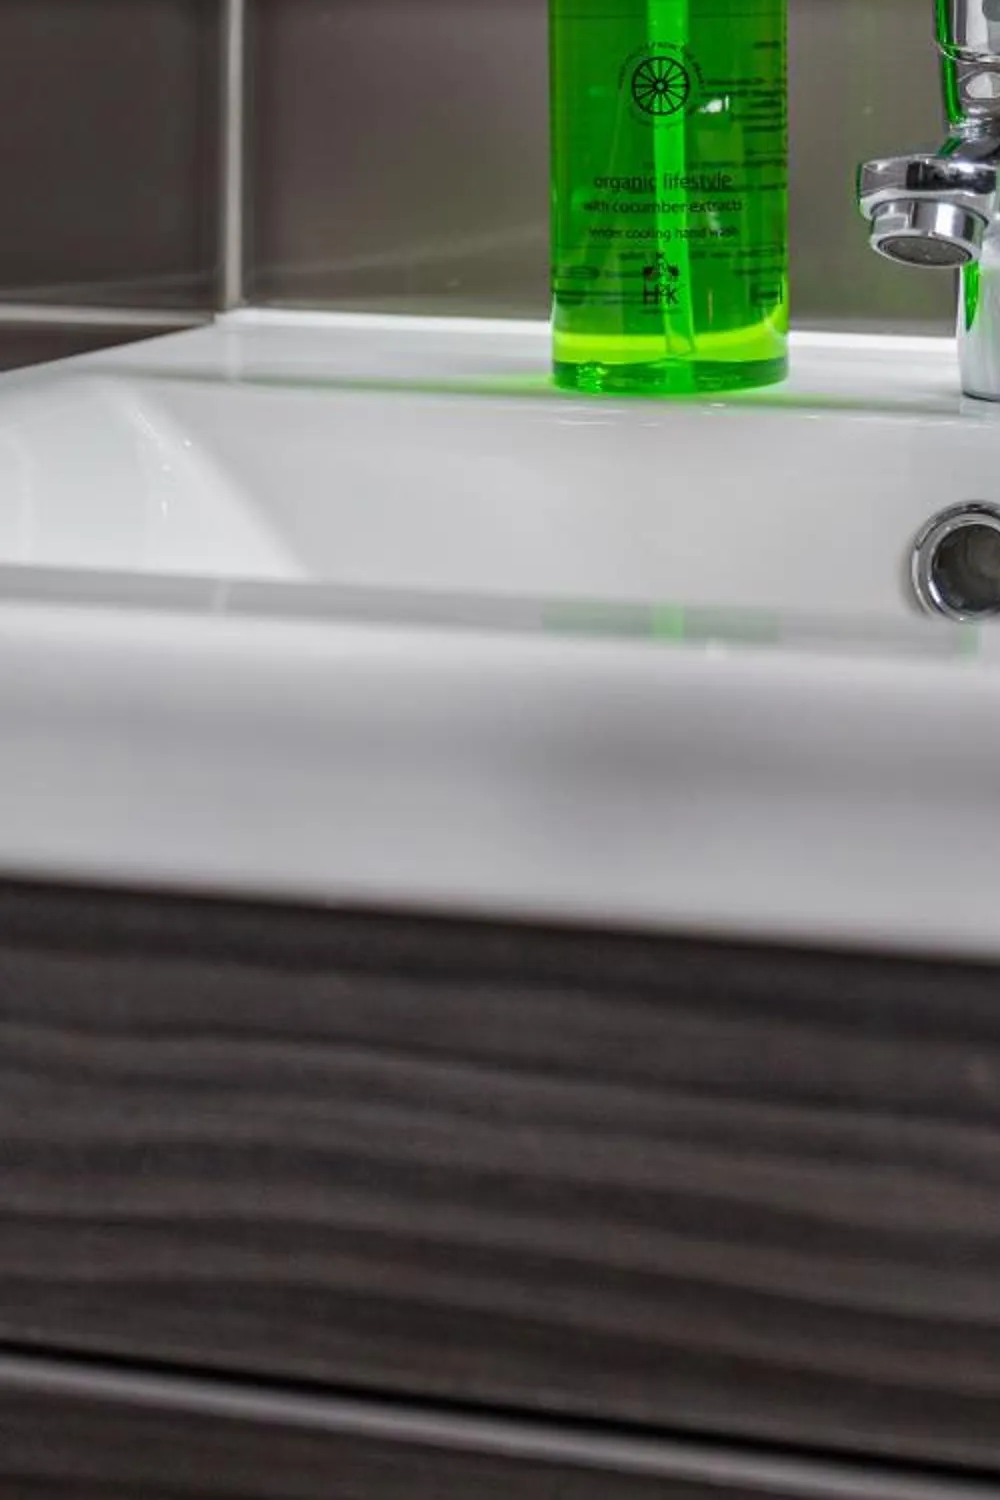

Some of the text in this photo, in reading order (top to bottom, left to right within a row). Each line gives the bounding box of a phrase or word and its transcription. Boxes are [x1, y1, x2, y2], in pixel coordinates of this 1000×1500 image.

[594, 173, 656, 192] organic
[663, 171, 732, 192] lifestyle
[612, 200, 686, 214] cucumber
